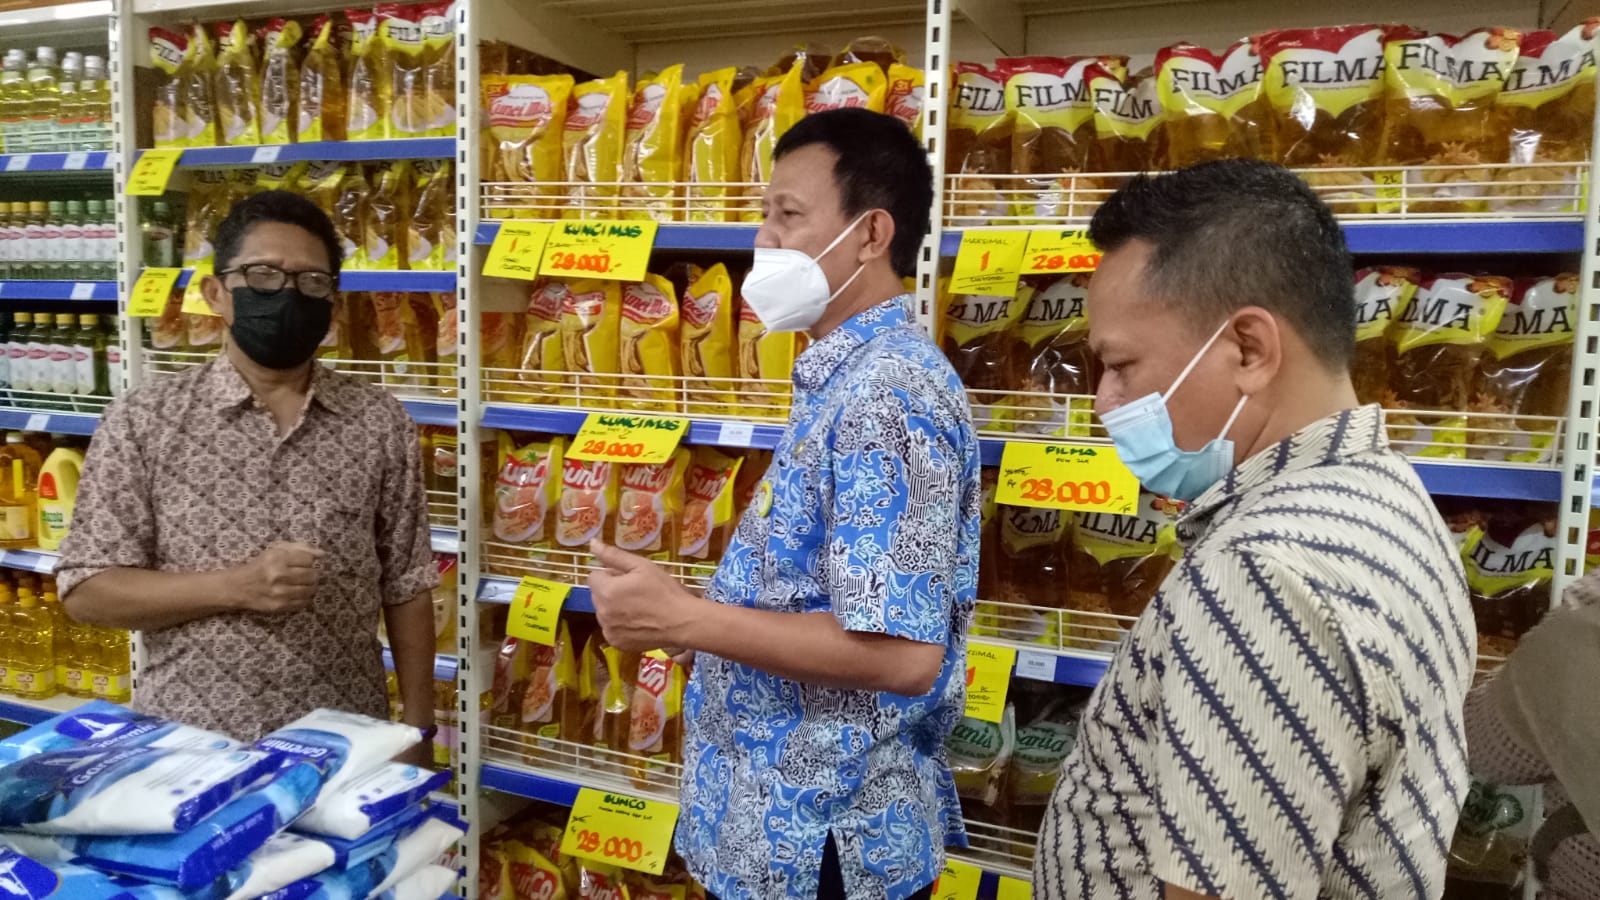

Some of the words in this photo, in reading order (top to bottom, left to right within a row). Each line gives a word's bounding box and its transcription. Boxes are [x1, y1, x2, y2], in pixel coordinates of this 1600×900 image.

[1396, 42, 1505, 84] FILMA
[563, 222, 606, 237] KUNCI
[980, 250, 991, 271] 1
[597, 415, 643, 429] KUNCI
[1045, 446, 1098, 457] FILMA
